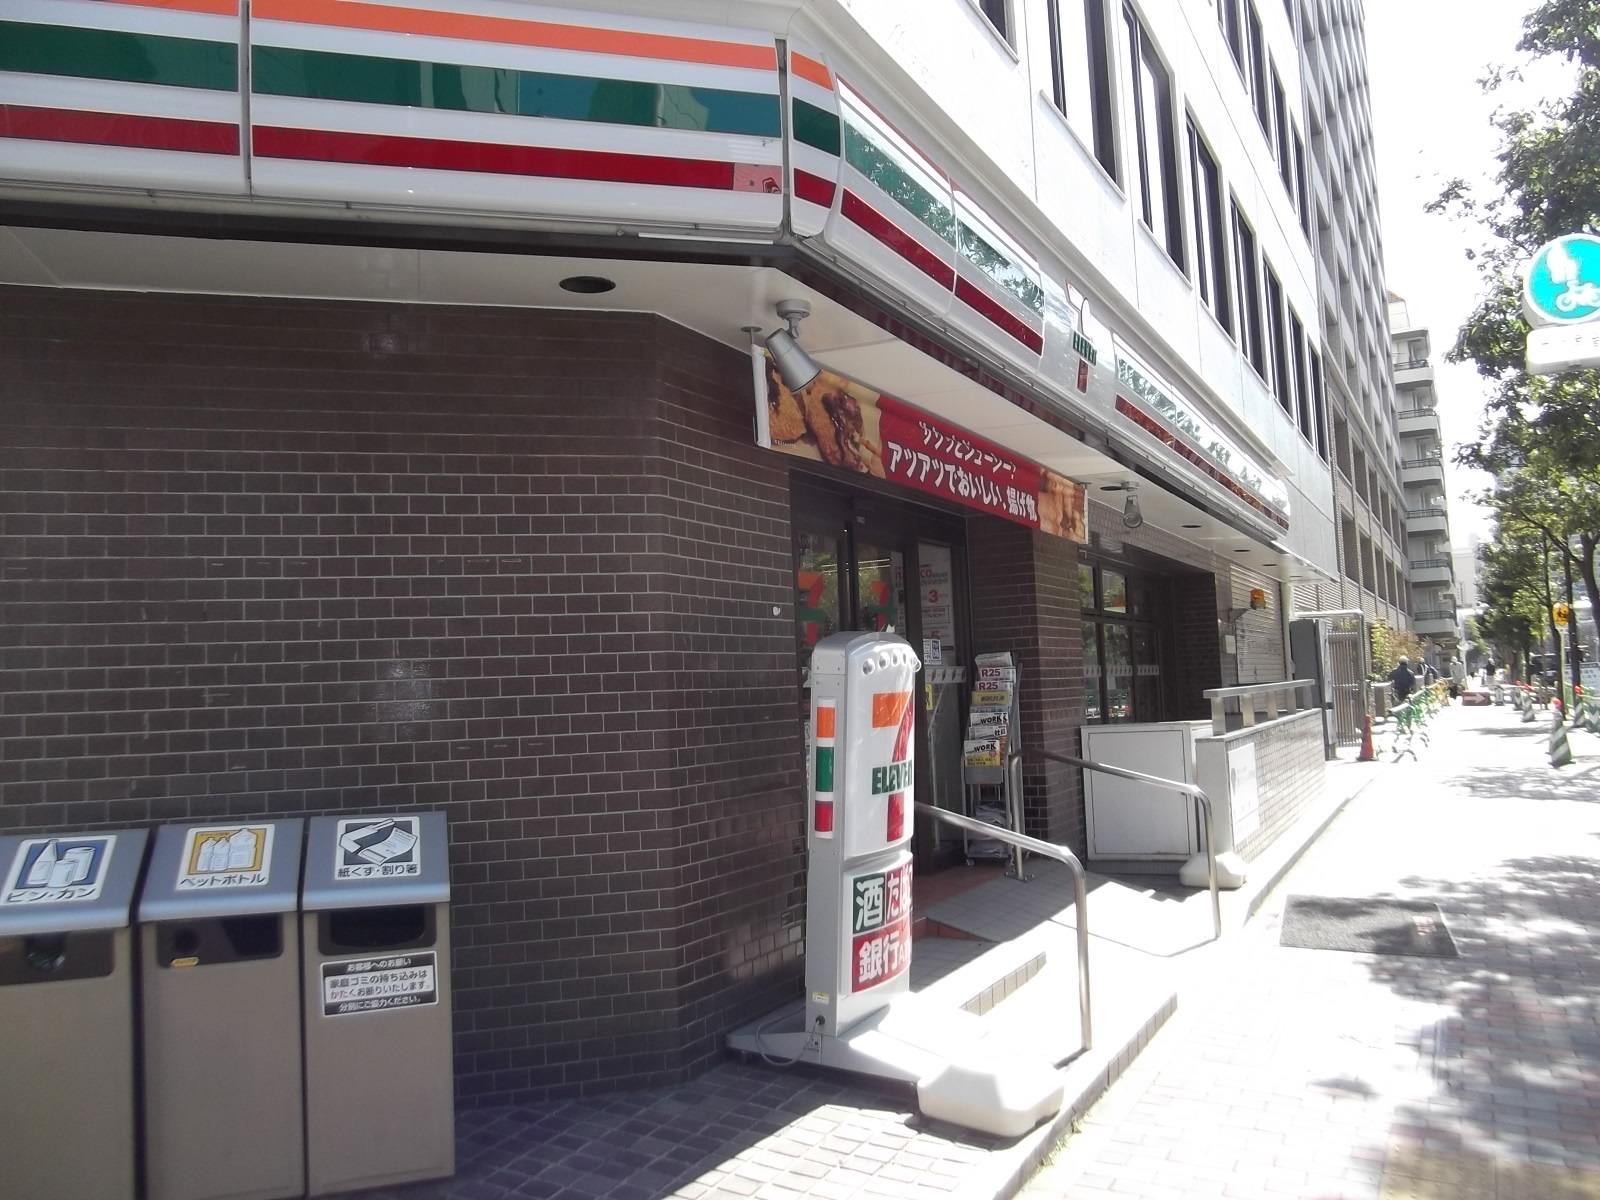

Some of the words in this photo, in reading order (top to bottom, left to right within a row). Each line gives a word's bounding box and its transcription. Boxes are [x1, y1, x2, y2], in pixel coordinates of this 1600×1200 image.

[179, 873, 266, 887] ペットボトル
[855, 876, 885, 931] 酒
